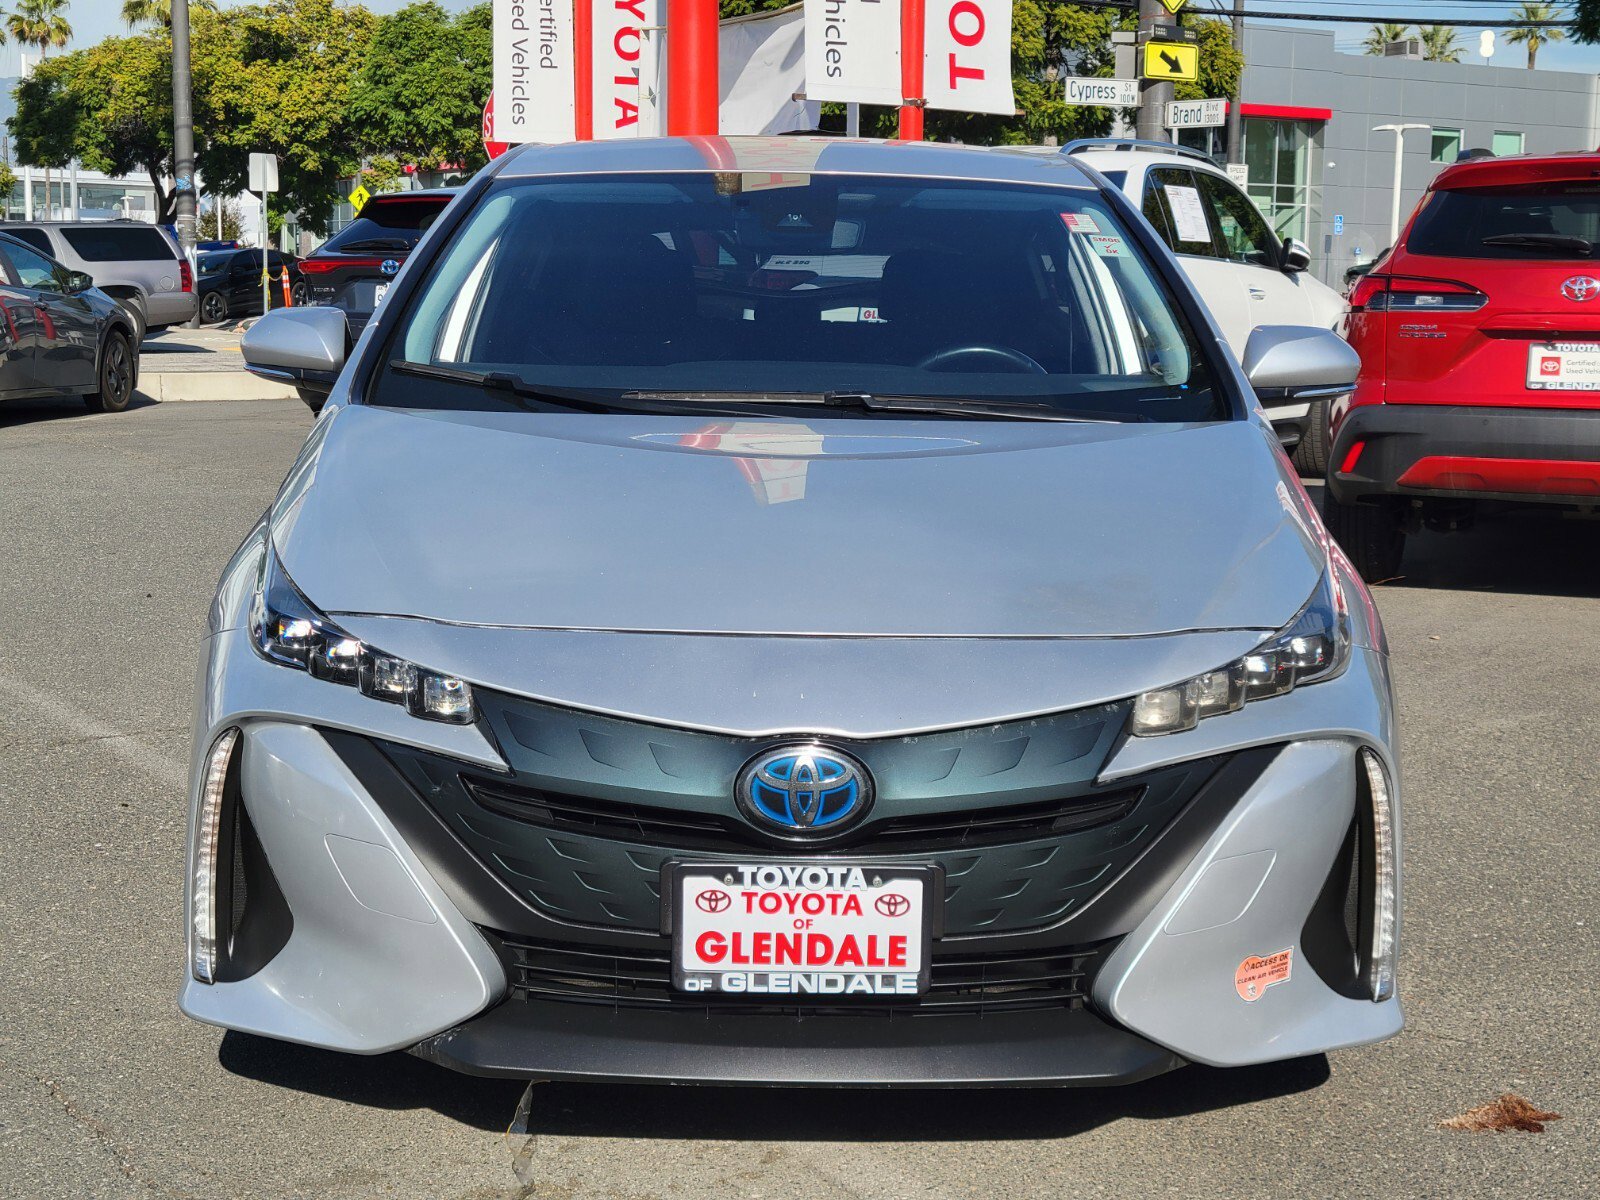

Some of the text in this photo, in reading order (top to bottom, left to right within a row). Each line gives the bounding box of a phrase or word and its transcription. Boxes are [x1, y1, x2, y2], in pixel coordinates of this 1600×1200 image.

[948, 0, 985, 90] TO
[511, 38, 530, 125] Vehicles
[1070, 80, 1132, 101] Cypress St
[1173, 102, 1219, 124] Brand Blvd
[737, 866, 868, 891] TOYOTA
[741, 891, 863, 917] TOYOTA
[793, 918, 813, 930] OF
[695, 930, 908, 968] GLENDALE
[1250, 956, 1277, 970] ACCESS
[1279, 953, 1289, 961] OK
[685, 972, 919, 994] OF GLENDALE
[1237, 975, 1256, 984] CLEAN
[1268, 966, 1288, 976] VEHICLE
